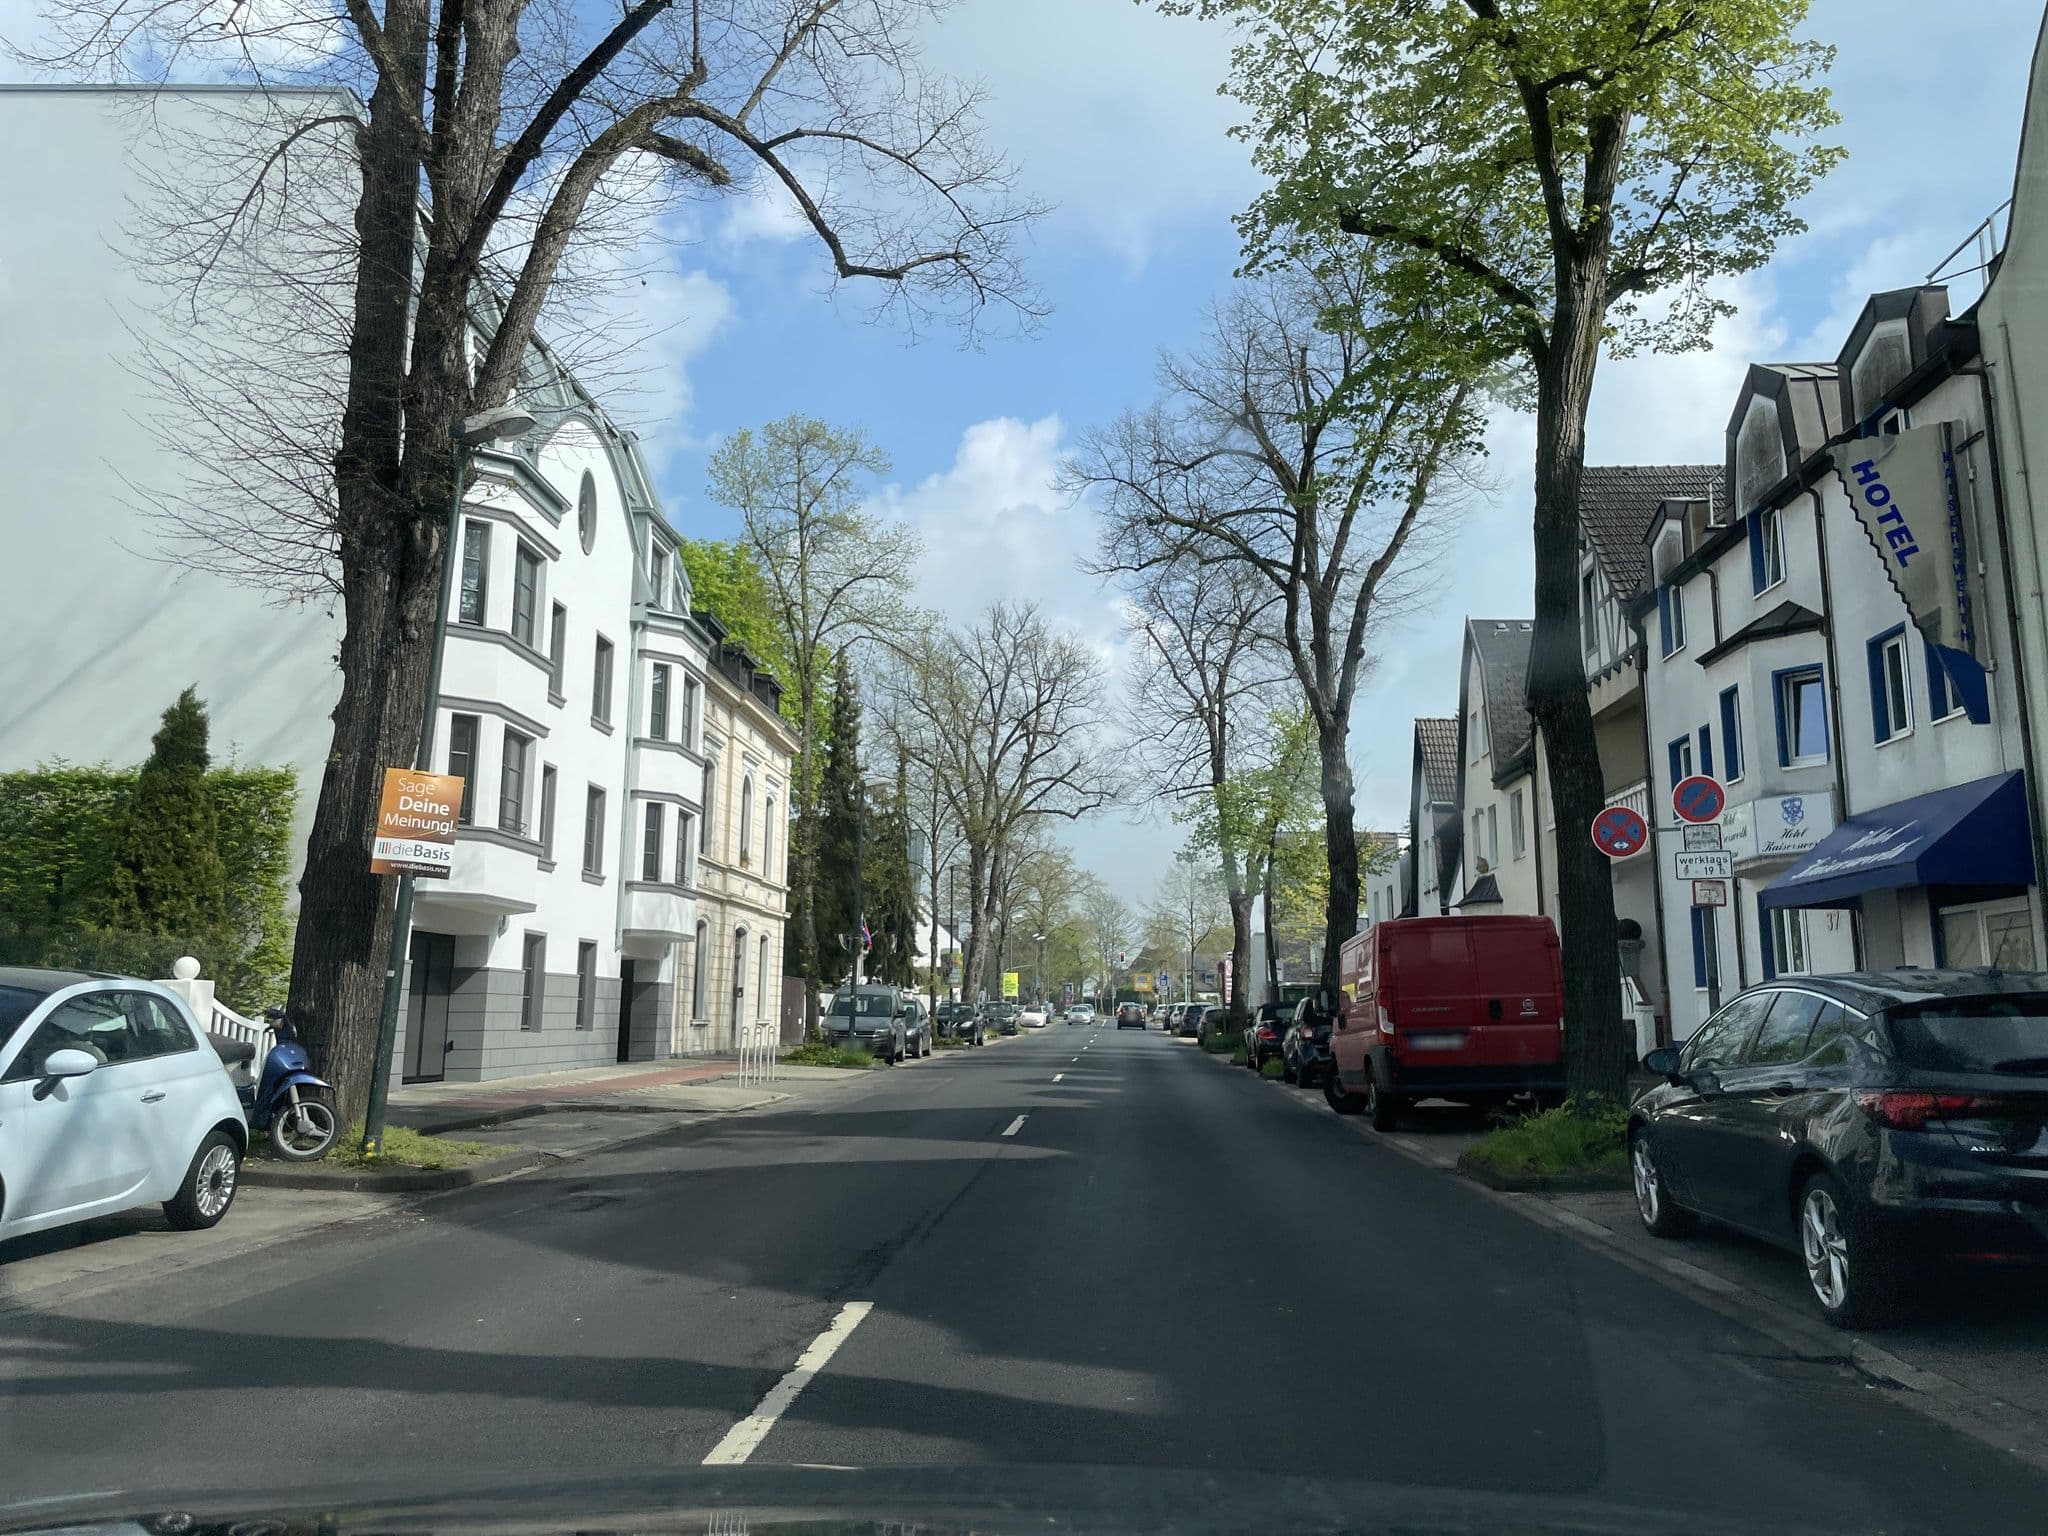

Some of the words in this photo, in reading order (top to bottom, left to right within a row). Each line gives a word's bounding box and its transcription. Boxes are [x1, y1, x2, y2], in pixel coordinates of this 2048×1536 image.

[1851, 459, 1920, 568] HOTEL
[397, 778, 435, 796] Sage
[399, 796, 450, 815] Deine
[384, 812, 454, 836] Meinung!
[1781, 827, 1808, 839] Hotel
[392, 842, 450, 861] dieBasis
[1679, 854, 1728, 867] werktags
[390, 862, 448, 874] www.diebasis.nrw
[1704, 866, 1714, 876] 19
[1826, 909, 1840, 930] 37
